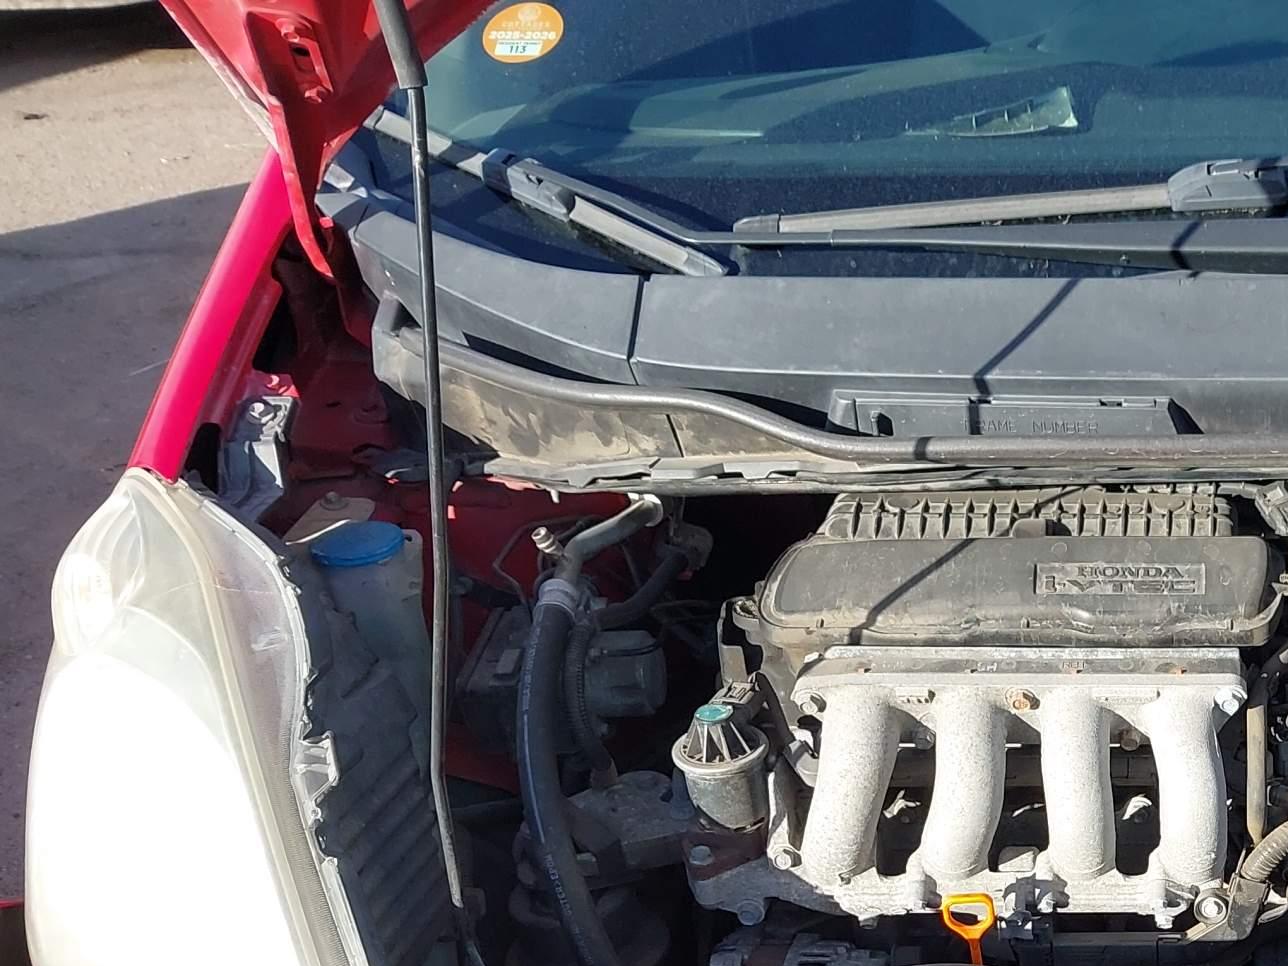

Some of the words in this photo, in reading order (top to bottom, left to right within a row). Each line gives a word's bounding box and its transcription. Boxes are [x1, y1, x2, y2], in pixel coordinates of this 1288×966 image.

[487, 30, 557, 40] 2025-2026
[509, 45, 528, 54] 113
[1031, 419, 1099, 434] NUMBER
[1076, 566, 1185, 578] HONDA
